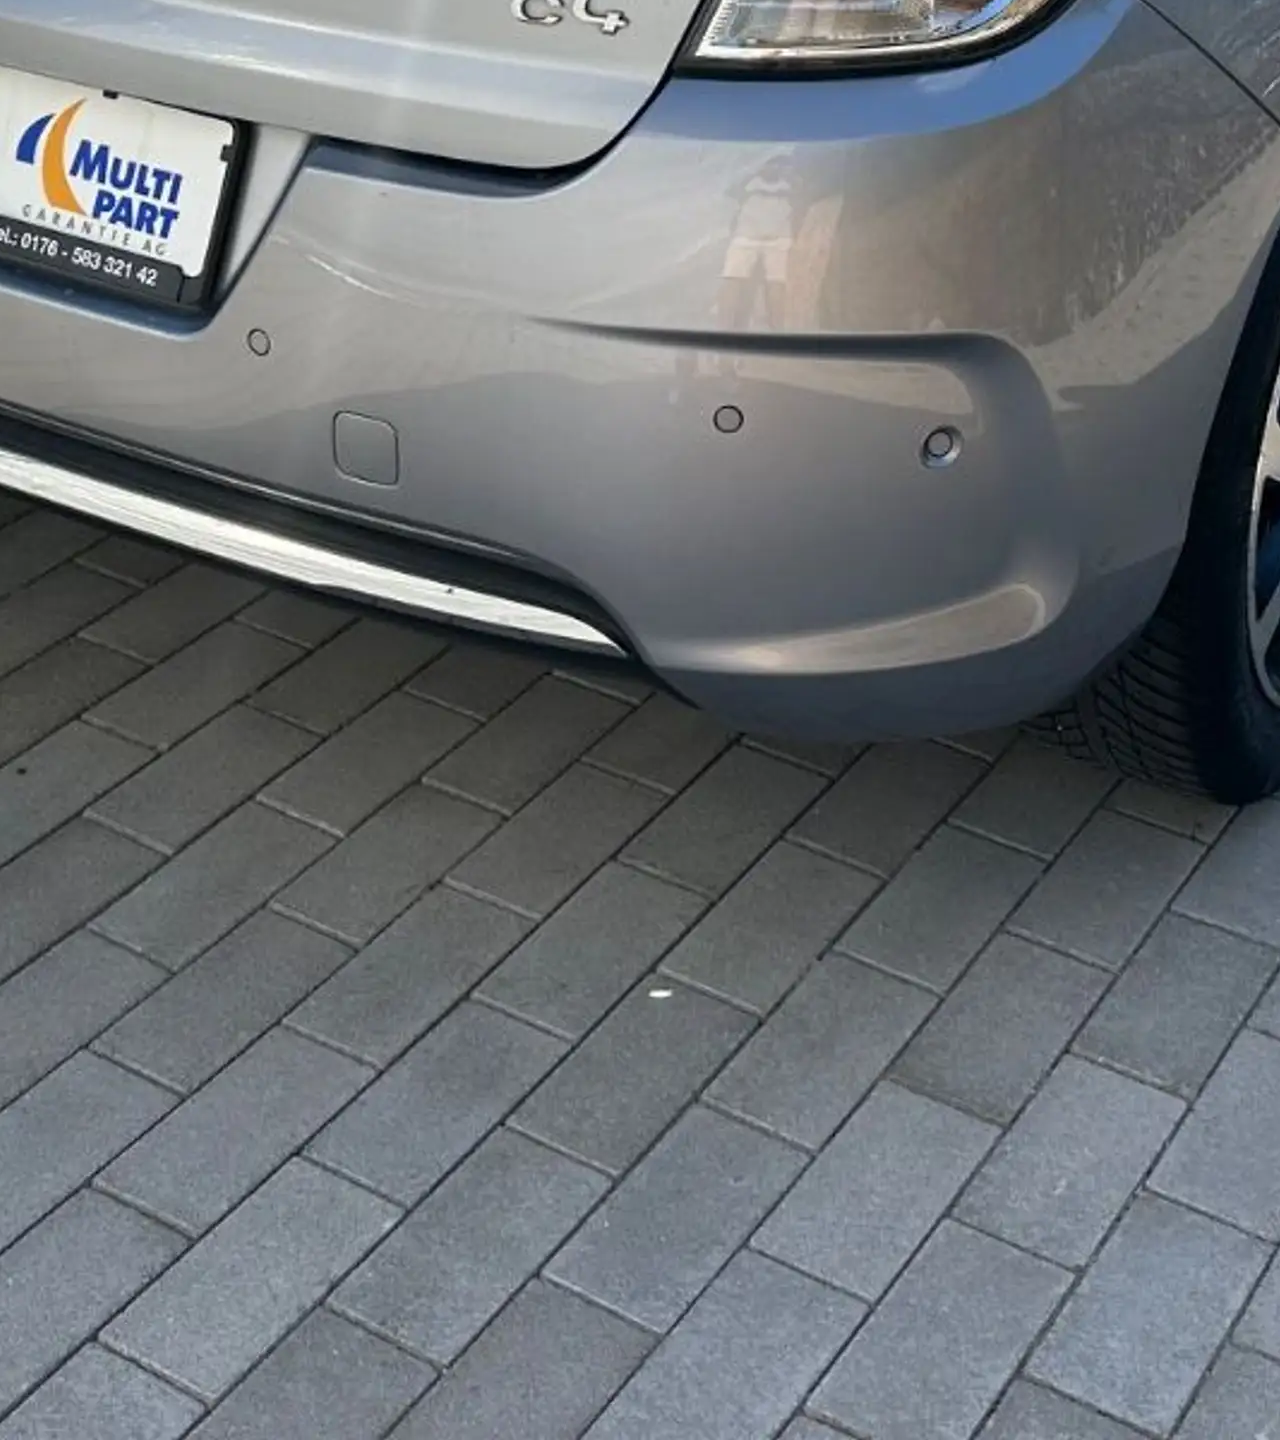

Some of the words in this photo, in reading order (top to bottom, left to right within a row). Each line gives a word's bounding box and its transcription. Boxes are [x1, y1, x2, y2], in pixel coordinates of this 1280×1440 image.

[69, 138, 183, 205] MULTI
[21, 203, 132, 246] GARANTIE
[92, 189, 180, 239] PART
[20, 232, 59, 258] 0176
[71, 247, 102, 271] 583
[103, 257, 132, 278] 321
[135, 267, 160, 288] 42
